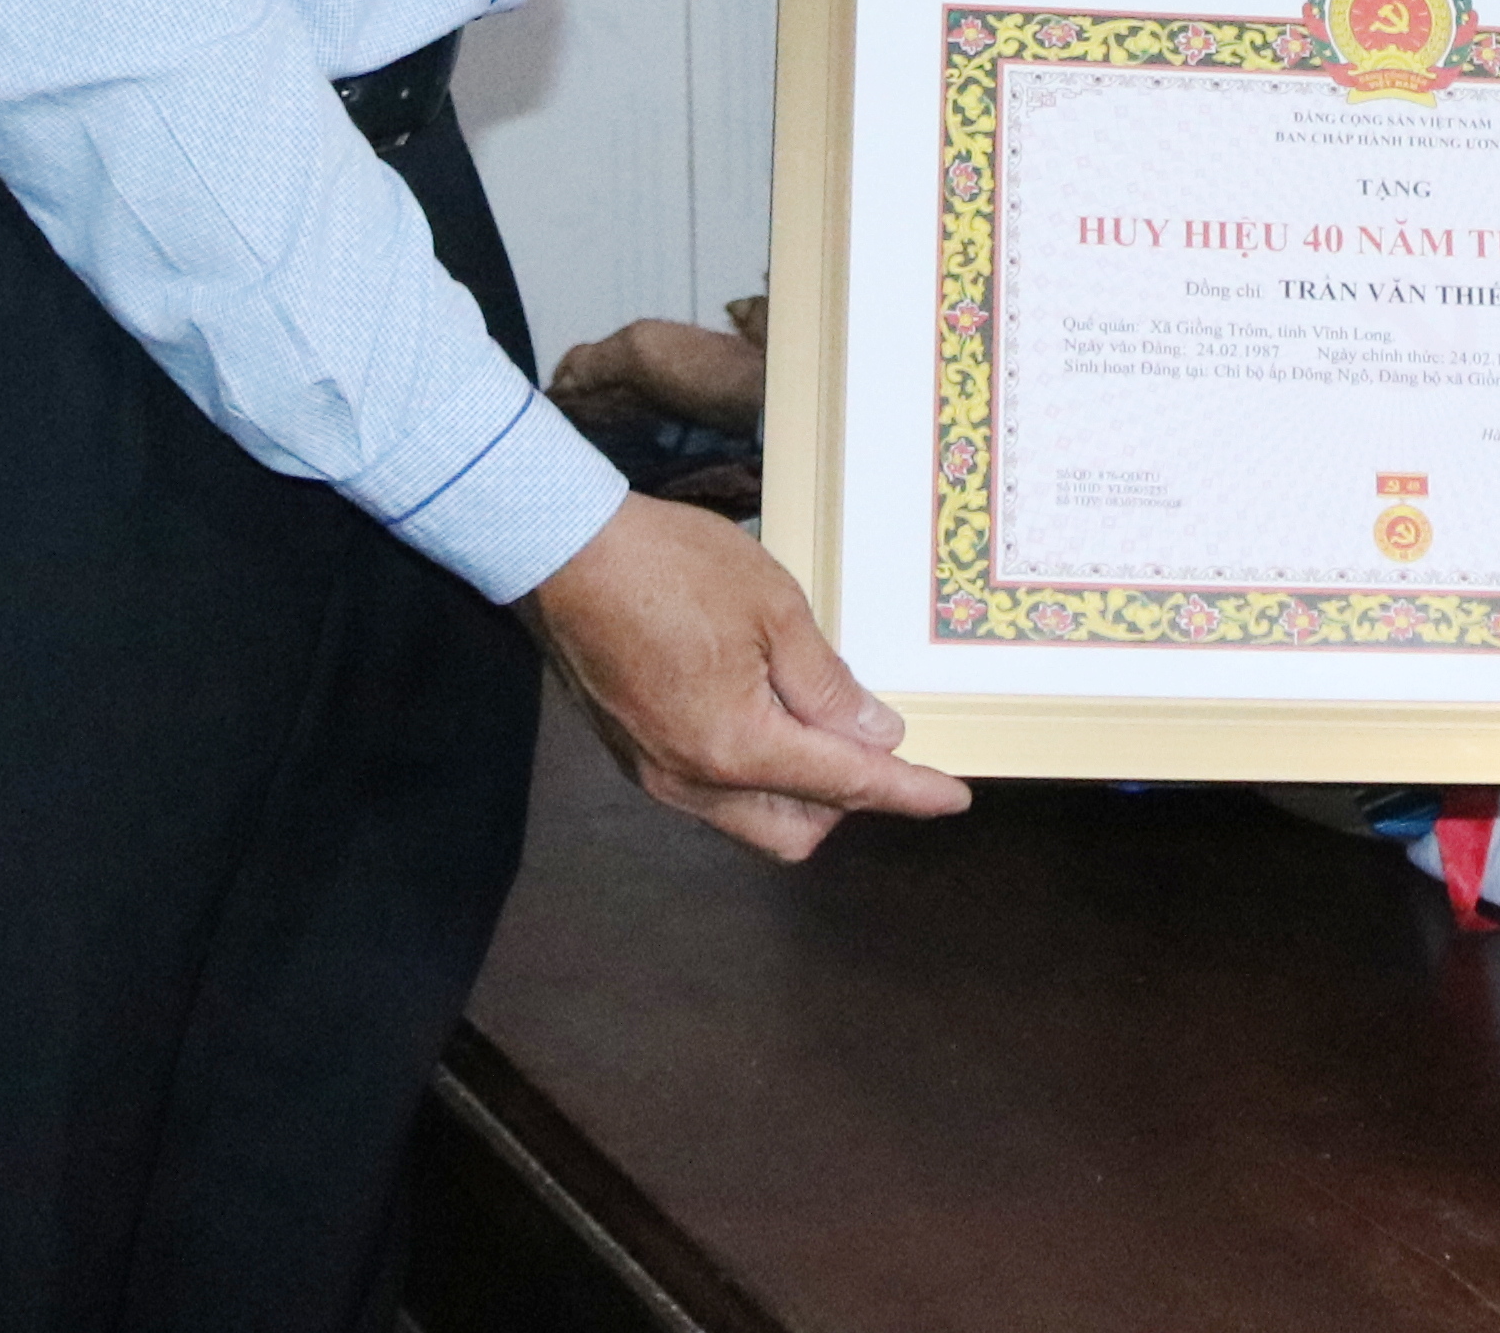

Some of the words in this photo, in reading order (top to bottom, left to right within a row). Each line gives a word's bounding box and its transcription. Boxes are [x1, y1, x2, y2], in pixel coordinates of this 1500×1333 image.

[1458, 117, 1493, 130] NAM
[1275, 130, 1307, 144] BAN
[1408, 135, 1462, 149] TRUNG
[1078, 216, 1170, 248] HUY
[1183, 216, 1289, 258] HIỆU
[1303, 223, 1343, 253] 40
[1357, 218, 1455, 257] NĂM
[1278, 274, 1358, 302] TRẦN
[1367, 277, 1427, 304] VĂN
[1150, 319, 1172, 334] Xã
[1176, 316, 1223, 339] Giồng
[1312, 325, 1349, 340] Vĩnh
[1063, 337, 1104, 356] Ngày
[1196, 343, 1280, 358] 24.02.1987
[1317, 346, 1358, 365] Ngày
[1362, 348, 1403, 363] chính
[1063, 358, 1099, 374] Sinh
